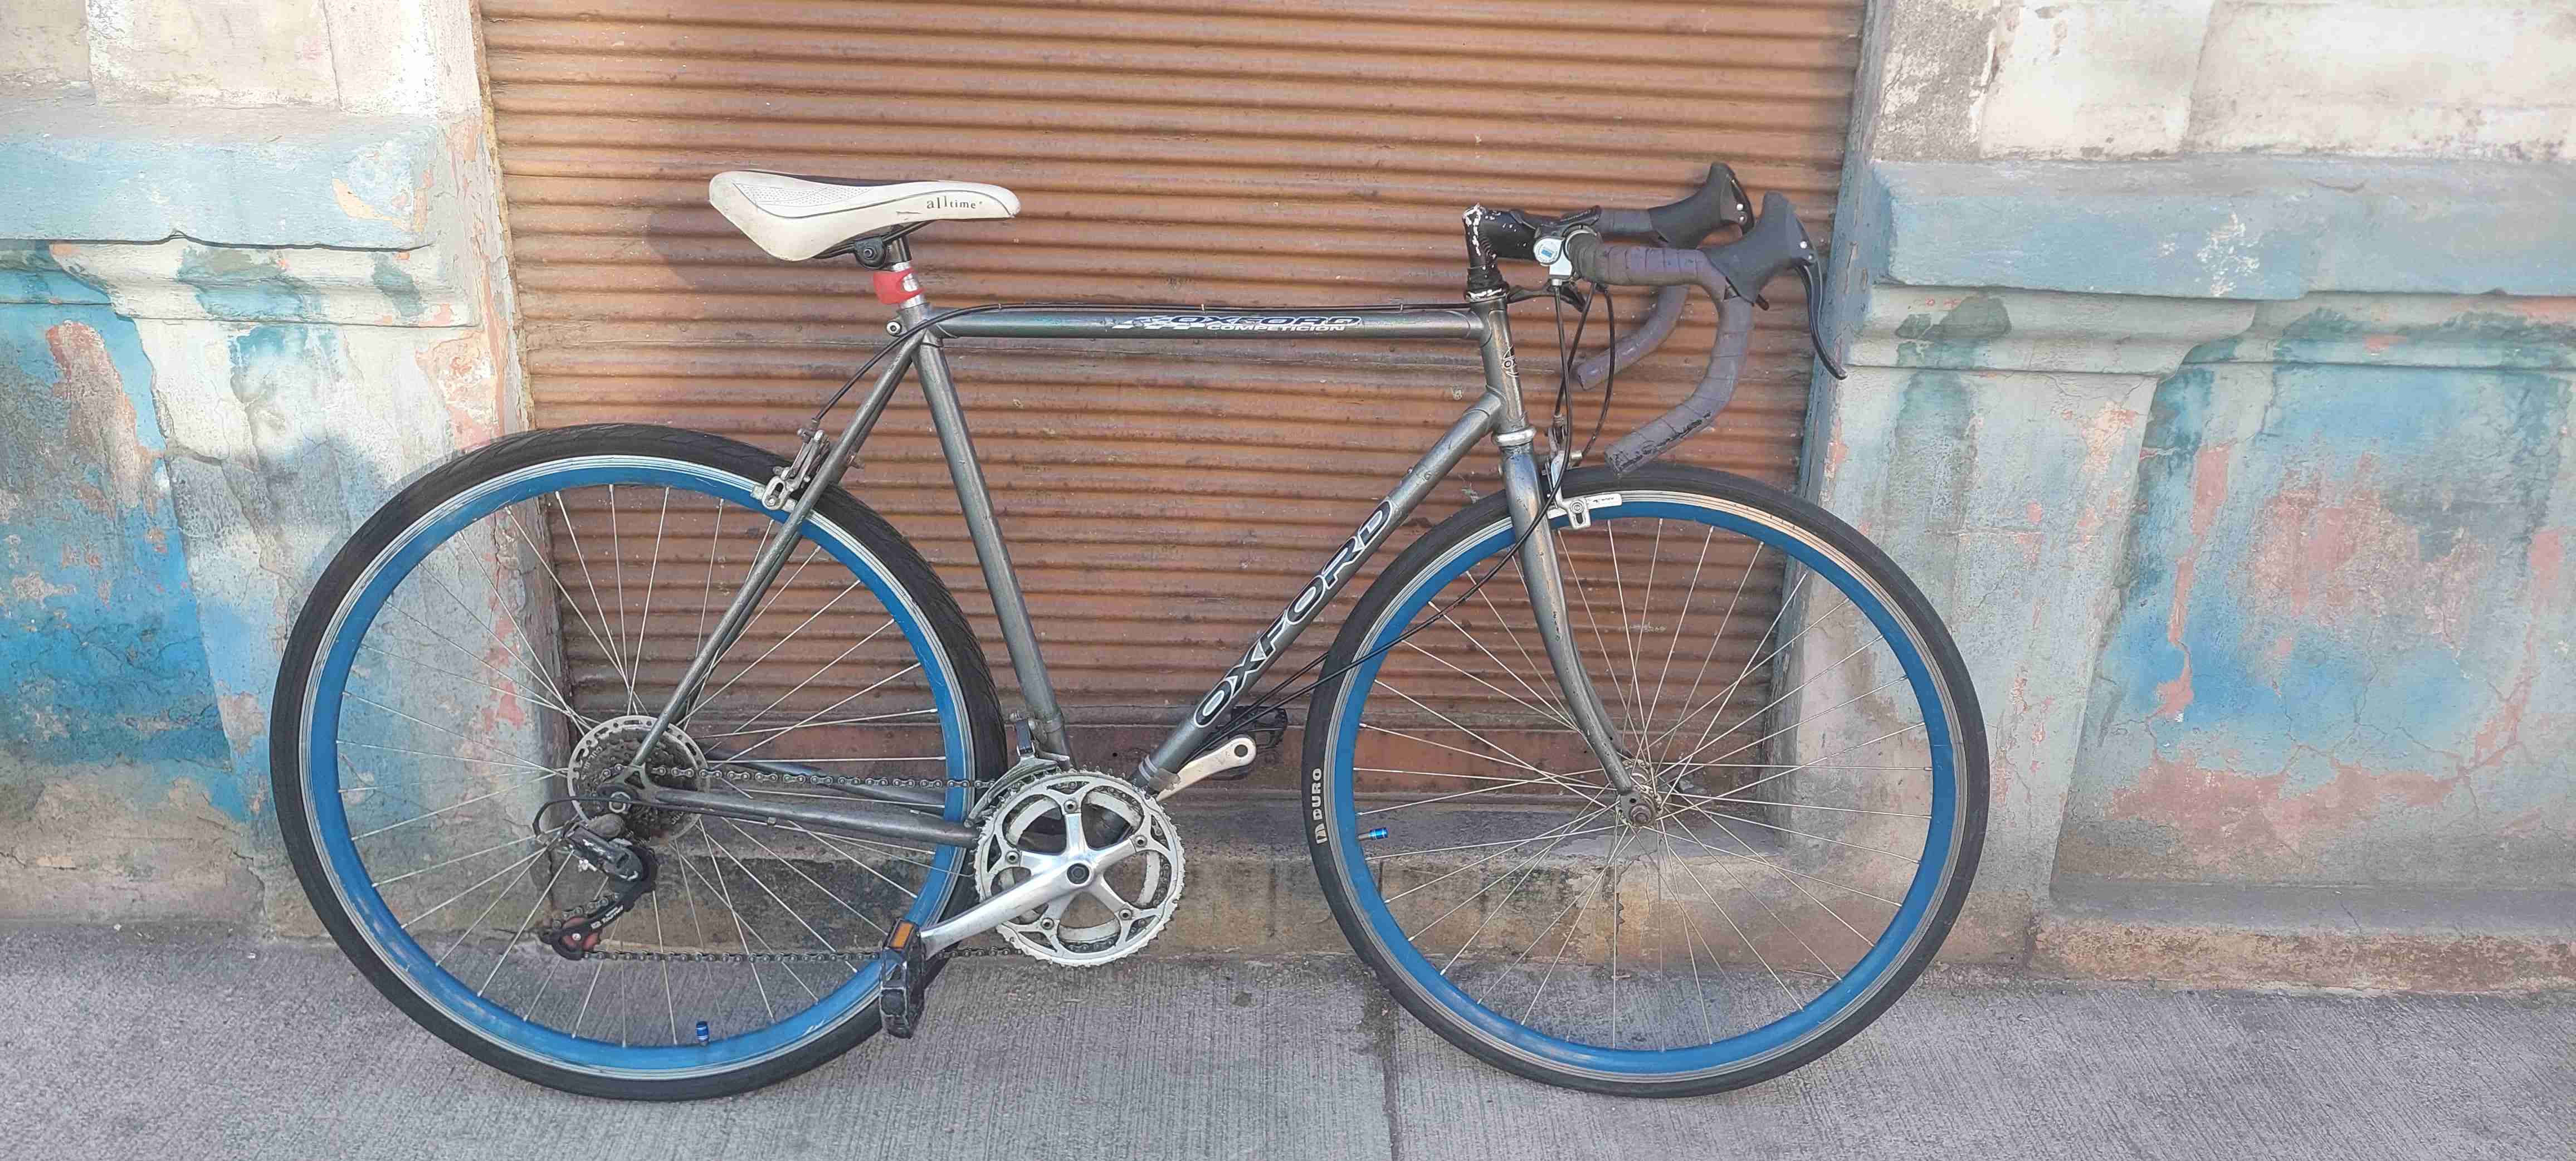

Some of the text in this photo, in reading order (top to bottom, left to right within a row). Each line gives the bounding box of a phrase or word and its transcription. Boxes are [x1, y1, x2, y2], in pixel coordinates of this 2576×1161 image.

[1170, 315, 1362, 326] OXFORD
[1194, 500, 1393, 727] OXFORD
[1311, 768, 1323, 820] DURO
